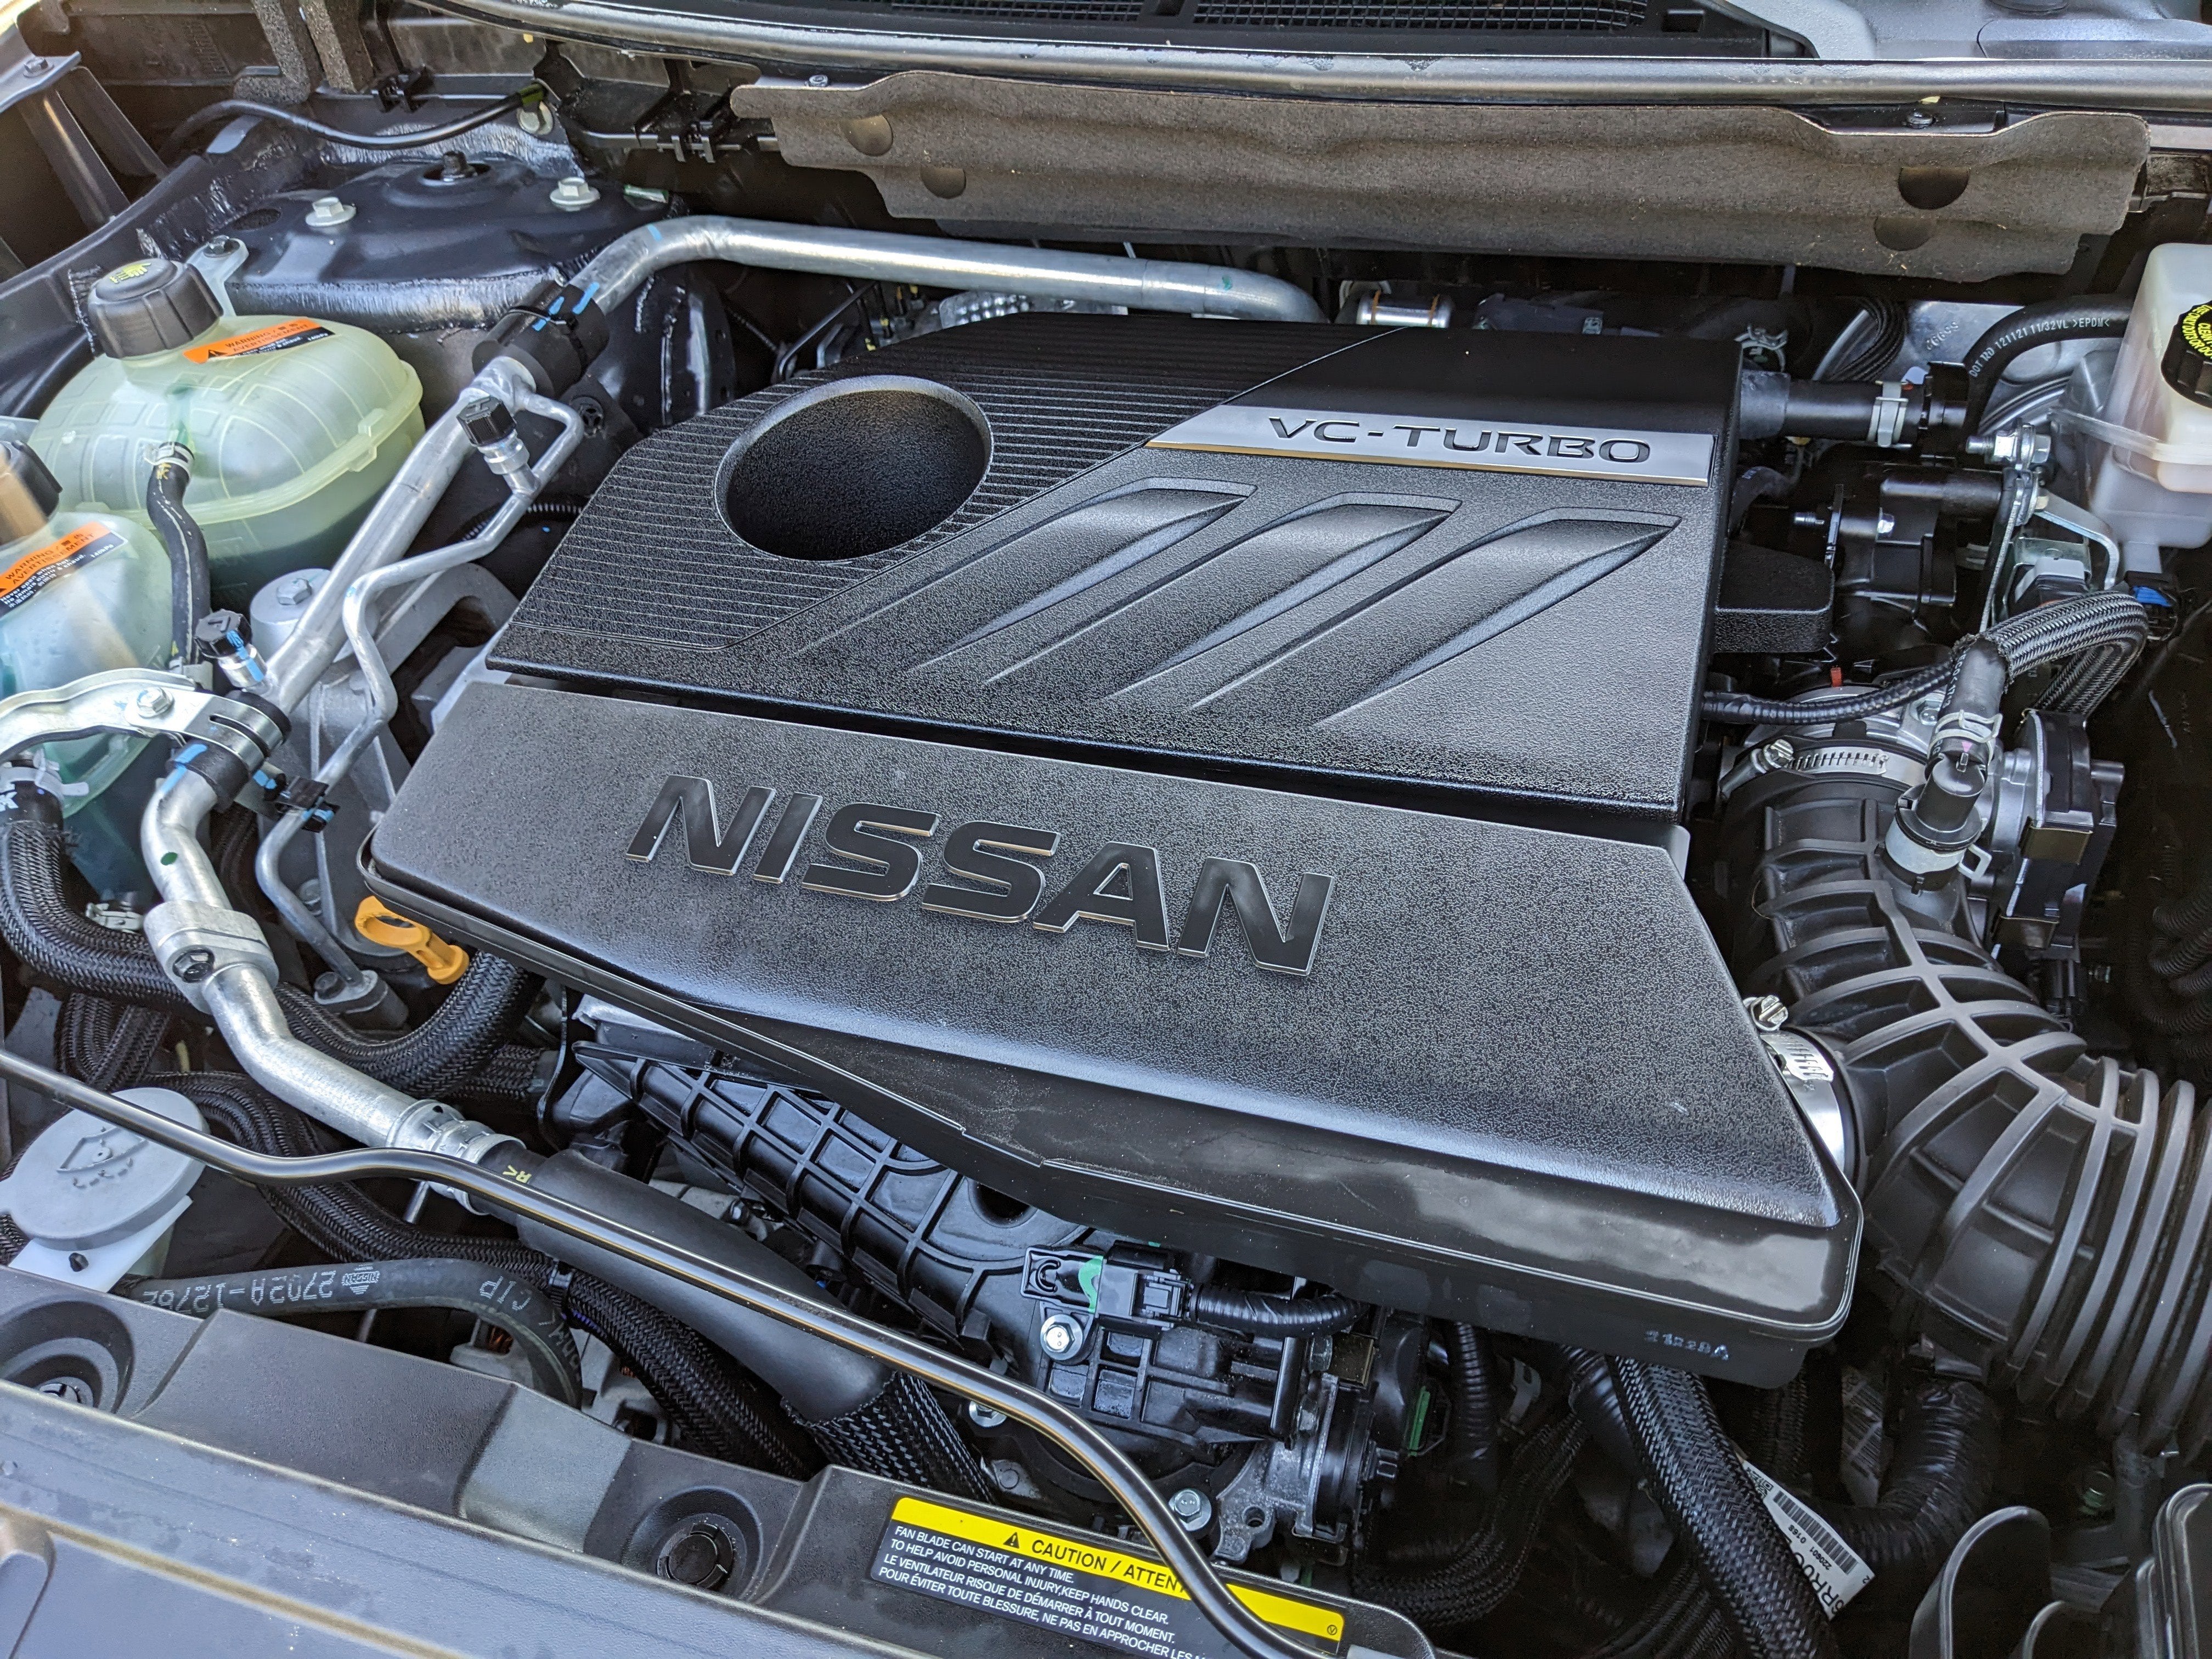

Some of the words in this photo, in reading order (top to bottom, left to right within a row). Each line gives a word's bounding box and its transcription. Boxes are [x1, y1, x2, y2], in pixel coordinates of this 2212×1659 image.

[2182, 325, 2198, 340] DOT3
[2183, 312, 2200, 325] ONLY
[225, 331, 271, 348] WARNING
[2188, 339, 2205, 349] OR
[1268, 415, 1651, 463] VC-TURBO
[5, 550, 54, 580] WARNING
[12, 533, 94, 585] AVERTISSEMENT
[625, 774, 1335, 977] NISSAN
[895, 1526, 916, 1539] FAN
[917, 1532, 950, 1549] BLADE
[952, 1542, 974, 1556] CAN
[975, 1548, 1010, 1564] START
[1010, 1557, 1024, 1568] AT
[1024, 1561, 1049, 1575] ANY
[1049, 1567, 1074, 1583] TIME.
[1032, 1539, 1107, 1571] CAUTION
[1109, 1560, 1122, 1573] /
[1809, 1546, 1832, 1571] 220601
[884, 1553, 898, 1565] LE
[899, 1558, 966, 1584] VENTILATEUR
[966, 1577, 1005, 1596] RISQUE
[1006, 1588, 1023, 1601] DE
[1024, 1591, 1085, 1618] DÉMARRER
[1084, 1606, 1093, 1620] À
[1095, 1611, 1124, 1629] TOUT
[1124, 1620, 1175, 1644] MOMENT.
[891, 1538, 905, 1551] TO
[905, 1543, 934, 1558] HELP
[934, 1551, 966, 1567] AVOID
[967, 1560, 1023, 1584] PERSONAL
[1090, 1594, 1129, 1613] HANDS
[1131, 1605, 1169, 1625] CLEAR.
[879, 1566, 910, 1584] POUR
[910, 1573, 946, 1593] ÉVITER
[947, 1585, 981, 1604] TOUTE
[982, 1595, 1039, 1622] BLESSURE,
[1042, 1612, 1058, 1626] NE
[1059, 1617, 1082, 1632] PAS
[1082, 1624, 1098, 1636] EN
[1099, 1628, 1170, 1657] APPROCHER
